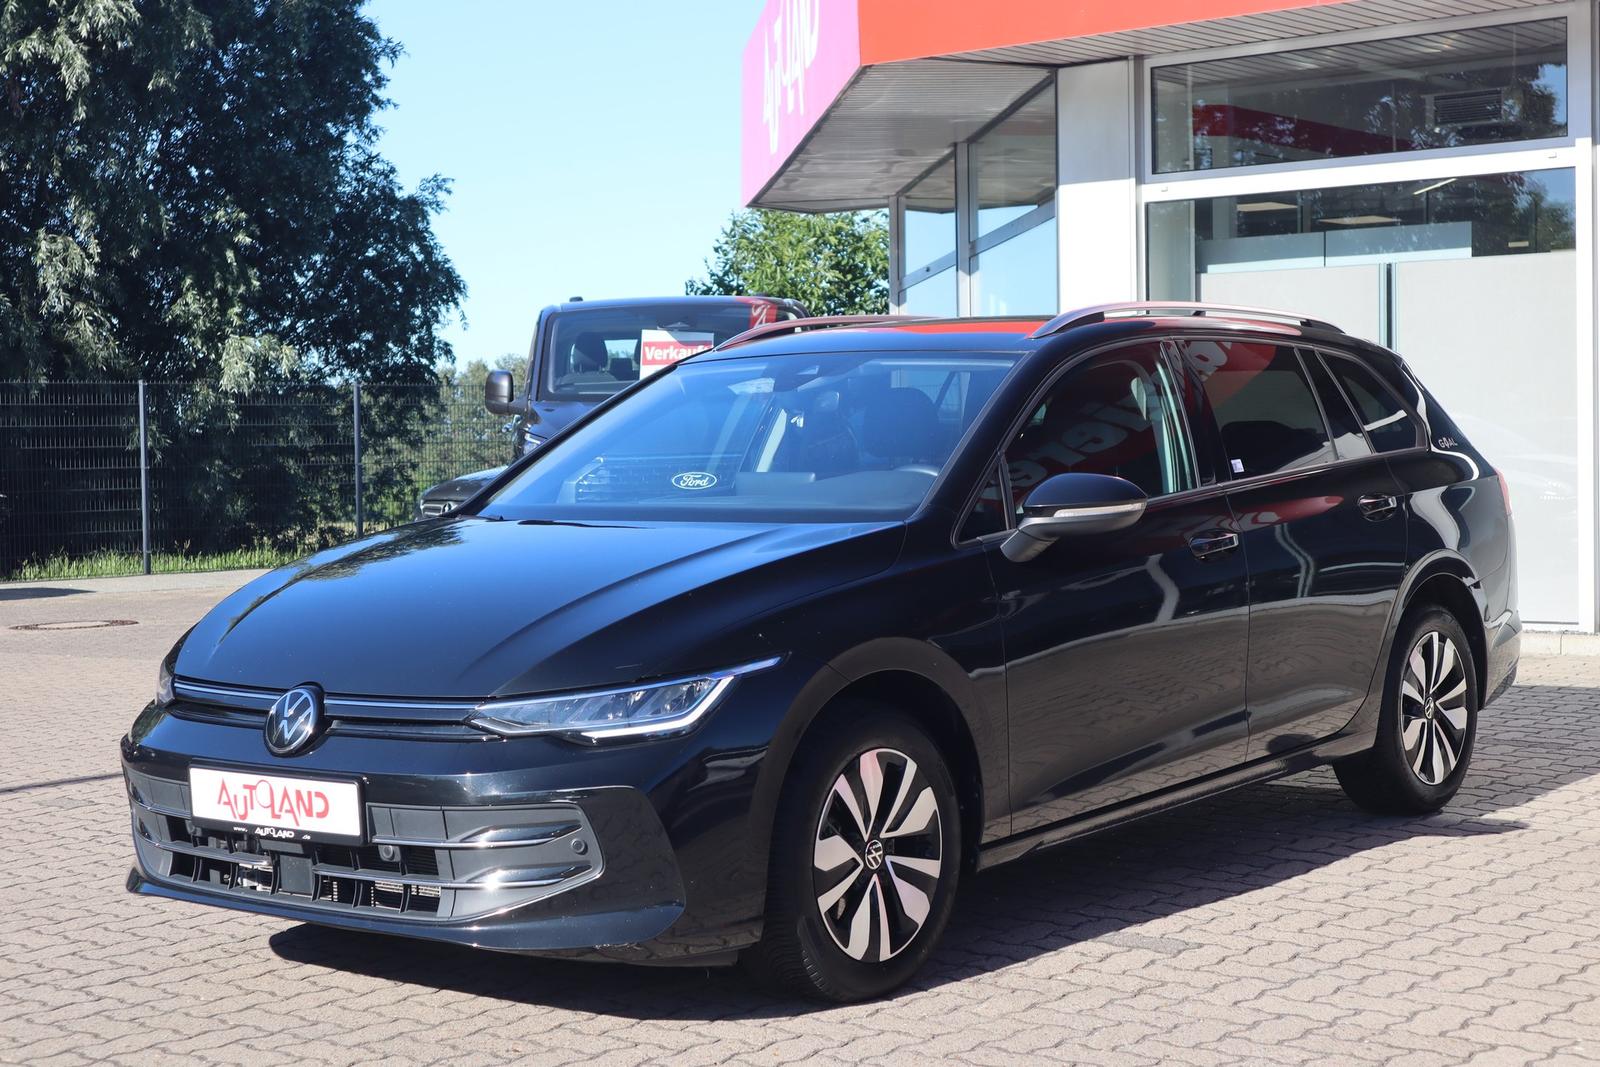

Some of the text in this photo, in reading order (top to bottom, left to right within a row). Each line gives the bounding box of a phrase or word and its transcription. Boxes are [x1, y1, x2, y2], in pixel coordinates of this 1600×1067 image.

[680, 474, 709, 486] Ford
[217, 778, 329, 827] AUTOLAND
[255, 827, 294, 839] AUTOLAND
